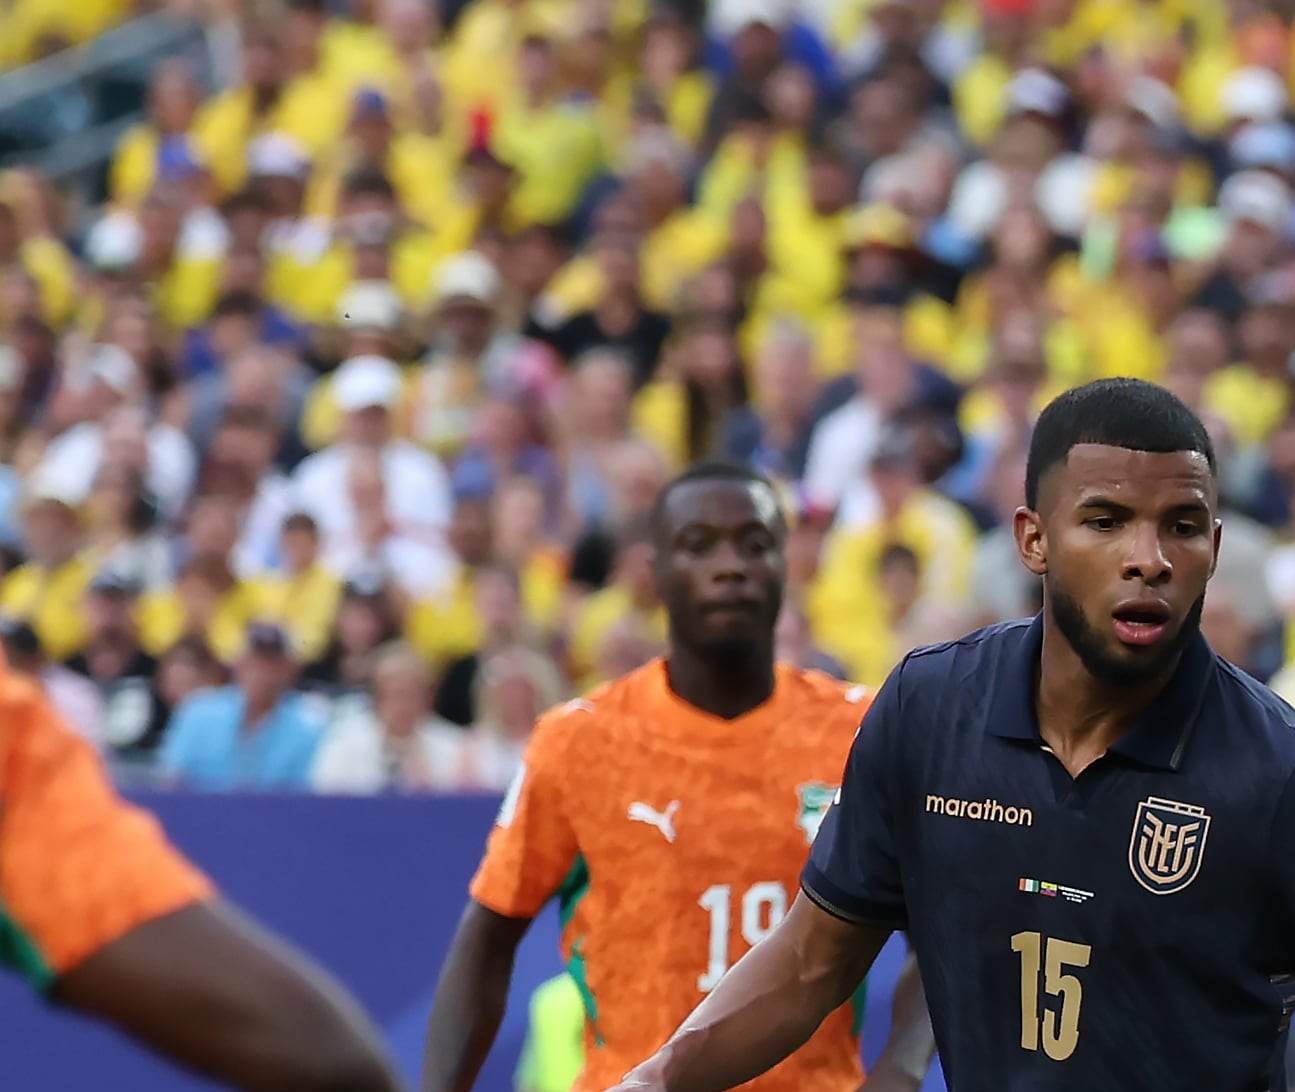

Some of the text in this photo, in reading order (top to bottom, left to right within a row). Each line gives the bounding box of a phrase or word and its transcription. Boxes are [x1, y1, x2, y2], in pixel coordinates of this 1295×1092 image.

[925, 794, 1033, 827] marathon
[698, 881, 788, 993] 19
[1010, 931, 1092, 1061] 15
